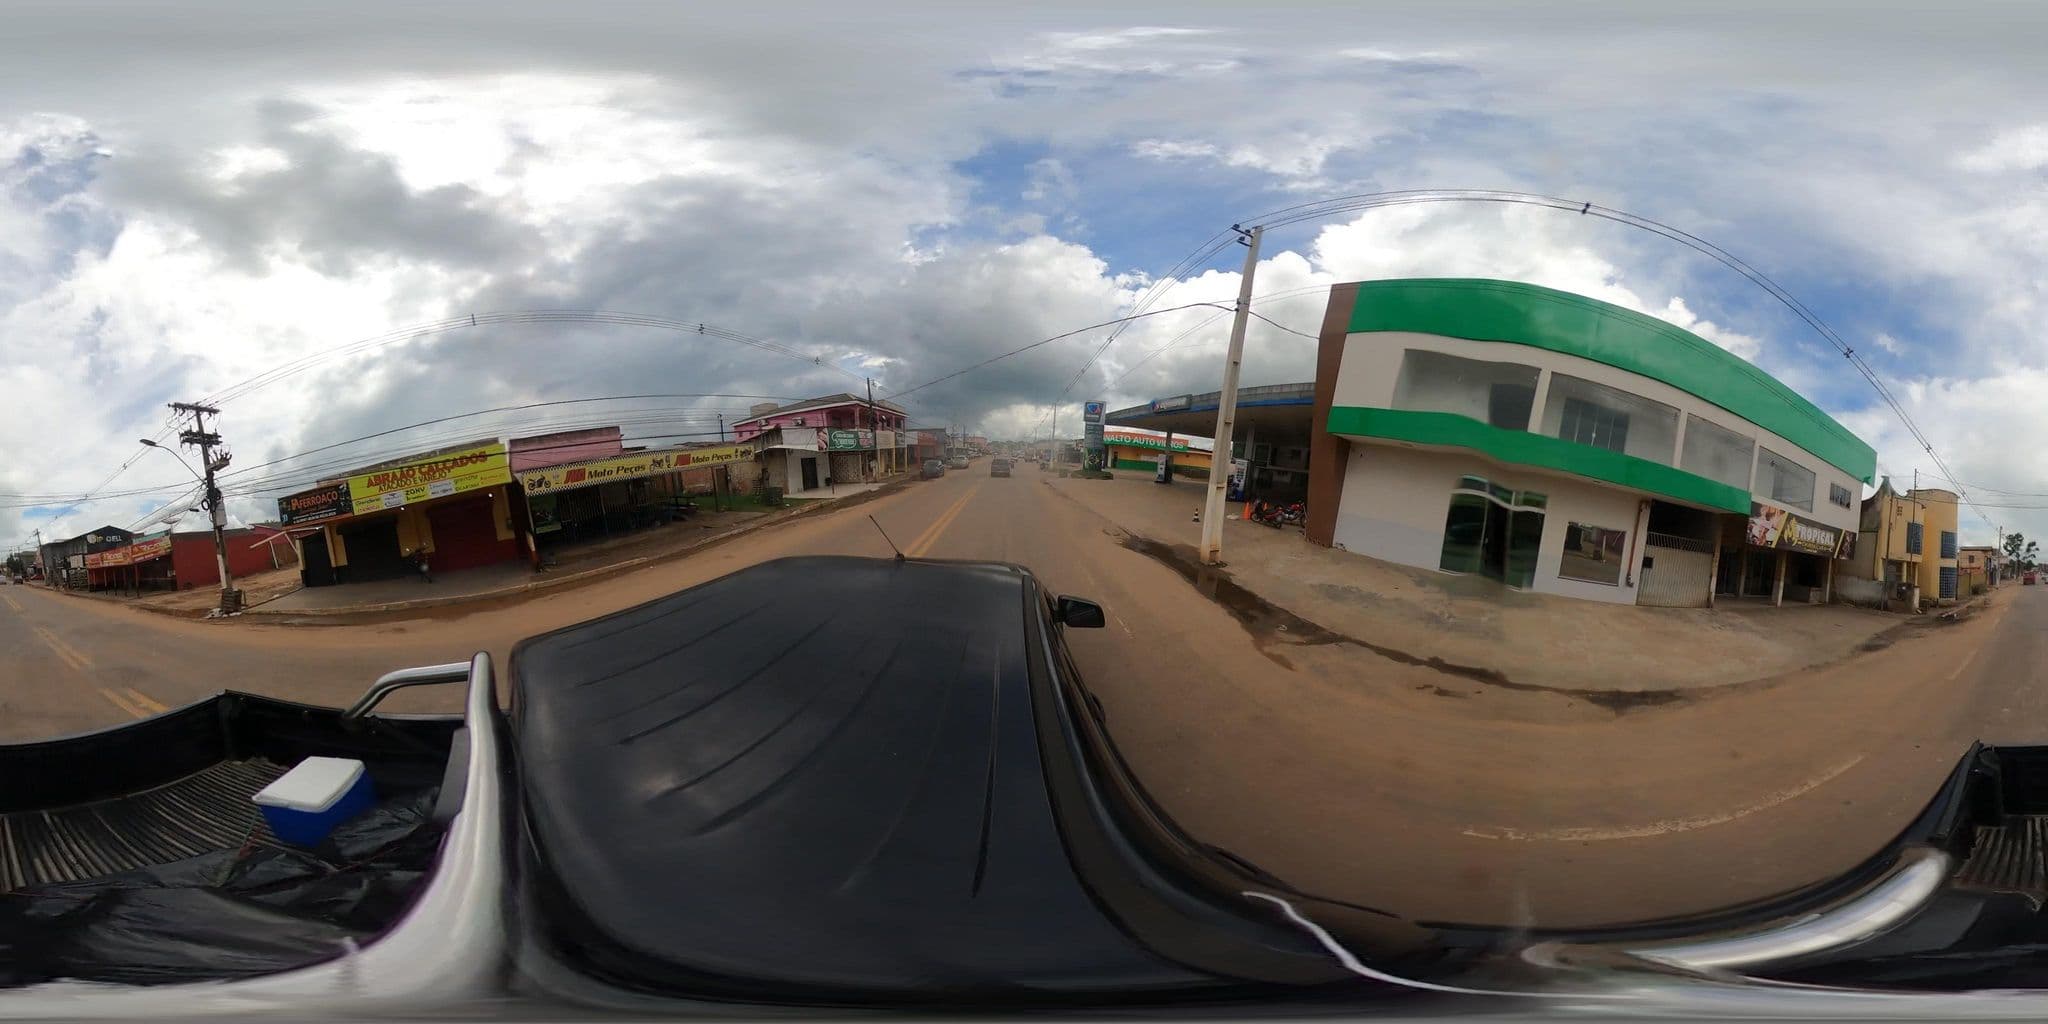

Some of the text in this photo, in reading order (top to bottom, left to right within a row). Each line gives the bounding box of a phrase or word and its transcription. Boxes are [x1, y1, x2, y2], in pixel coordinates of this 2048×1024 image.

[1133, 436, 1155, 446] AUTO
[418, 451, 487, 476] CALÇADOS
[692, 456, 710, 464] Moto
[587, 468, 613, 479] Moto
[616, 464, 646, 475] Peças
[378, 478, 412, 493] ATACADO
[1797, 525, 1834, 545] TROPICAL
